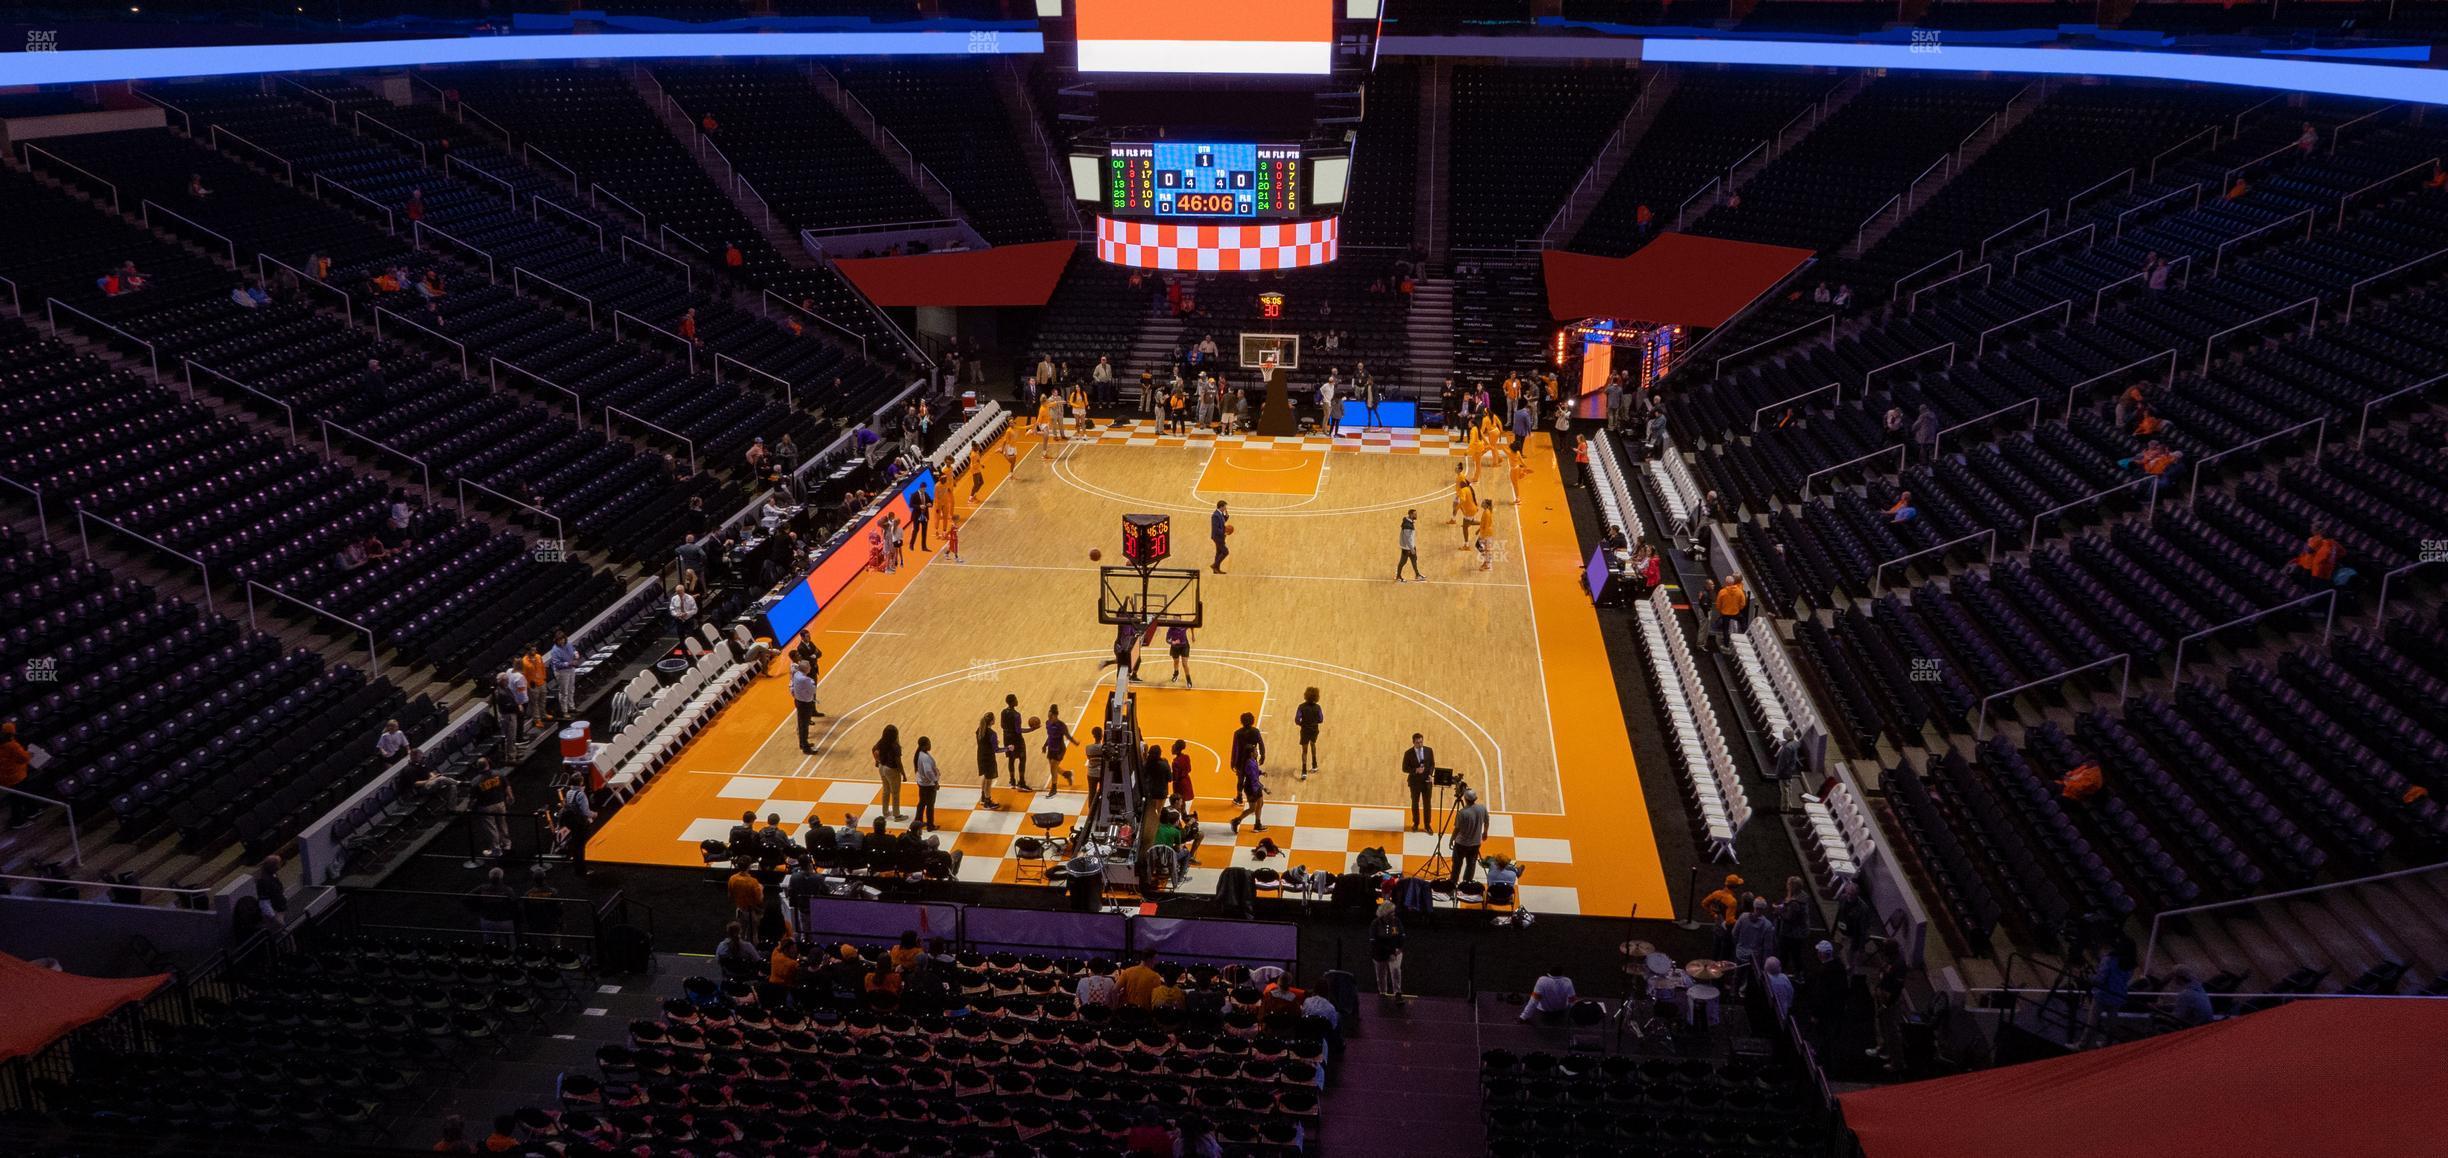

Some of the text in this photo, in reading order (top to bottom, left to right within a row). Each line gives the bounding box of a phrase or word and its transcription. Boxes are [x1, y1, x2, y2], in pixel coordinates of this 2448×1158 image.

[1112, 149, 1124, 157] PLR
[1126, 149, 1138, 157] FLS
[1258, 151, 1271, 159] PLR
[1273, 151, 1284, 159] FLS
[1113, 160, 1125, 168] 00
[1203, 155, 1208, 167] 1
[1261, 161, 1295, 170] 3 0 0
[1142, 170, 1152, 179] 17
[1259, 171, 1295, 181] 11 0 7
[1115, 180, 1125, 188] 13
[1144, 180, 1150, 188] 8
[1165, 173, 1173, 186] 0
[1187, 179, 1193, 188] 4
[1217, 179, 1223, 188] 4
[1237, 174, 1246, 187] 0
[1258, 182, 1295, 190] 20 2 7
[1114, 190, 1125, 198] 23
[1142, 190, 1153, 198] 10
[1258, 192, 1268, 200] 21
[1288, 192, 1295, 200] 2
[1114, 200, 1151, 208] 33 0 0
[1162, 203, 1169, 212] 0
[1177, 195, 1233, 212] 46:06
[1258, 201, 1295, 210] 24 0 0
[1241, 204, 1248, 213] 0
[1265, 304, 1279, 317] 30
[1147, 521, 1169, 537] 46:06
[1125, 534, 1136, 557] 30
[1151, 534, 1166, 558] 30
